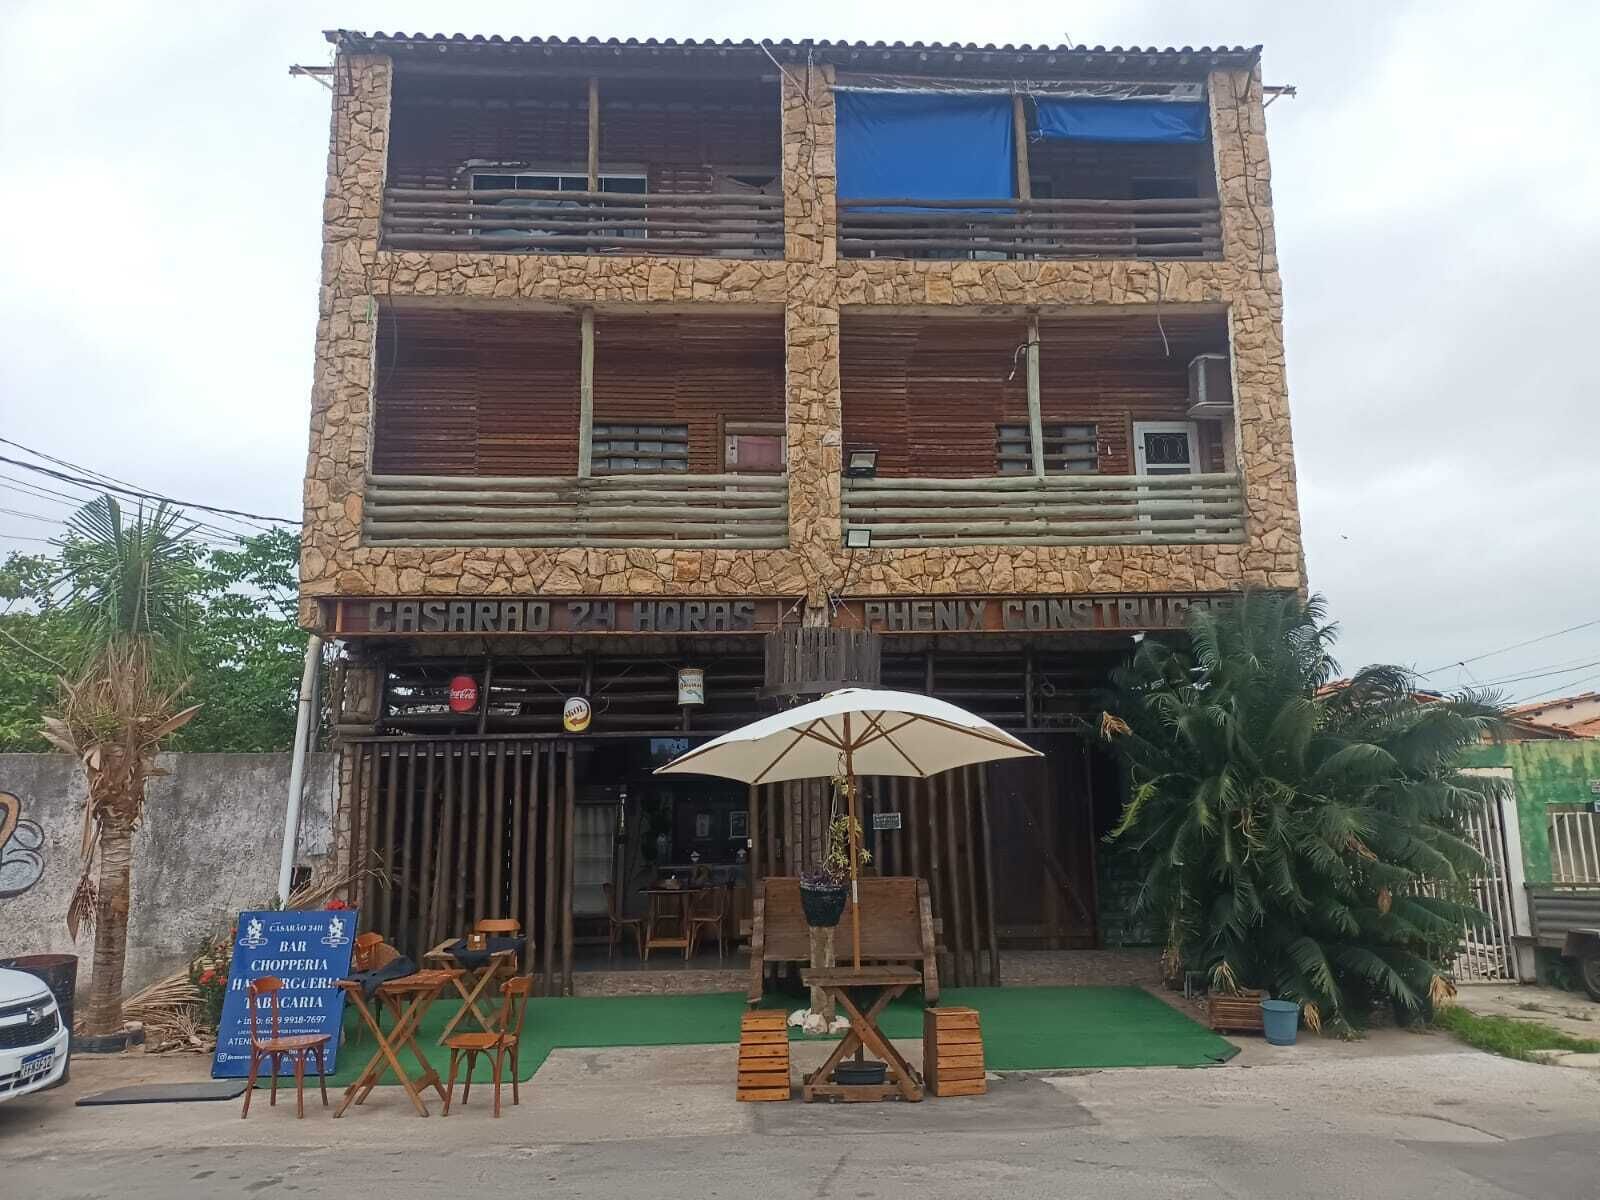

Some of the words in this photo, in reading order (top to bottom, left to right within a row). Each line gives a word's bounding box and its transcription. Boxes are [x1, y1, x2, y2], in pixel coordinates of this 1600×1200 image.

[567, 601, 616, 632] 24
[633, 601, 755, 632] HORAS
[864, 599, 988, 632] PHENIX
[280, 941, 307, 952] BAR
[251, 959, 328, 971] CHOPPERIA
